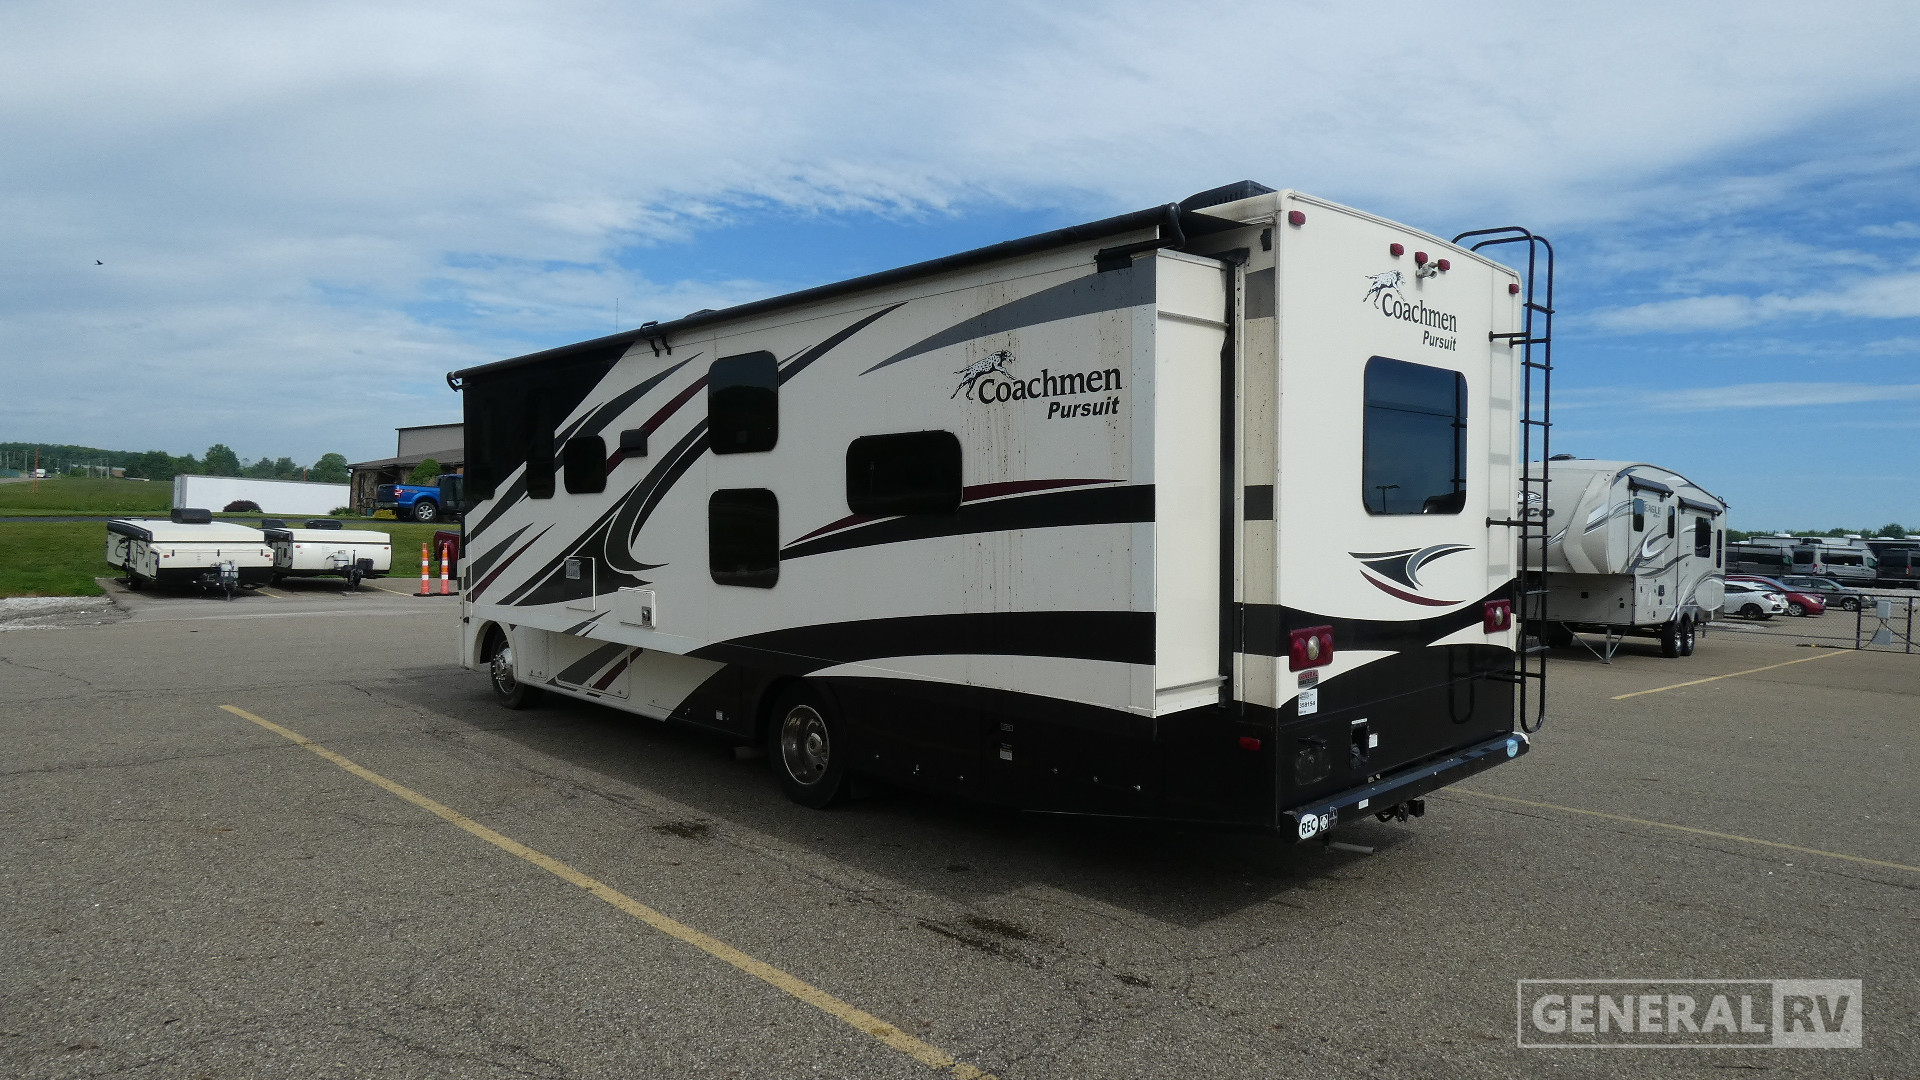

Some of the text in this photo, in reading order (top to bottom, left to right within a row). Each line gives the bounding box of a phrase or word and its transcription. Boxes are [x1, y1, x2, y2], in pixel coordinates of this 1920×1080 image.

[1381, 292, 1457, 332] Coachmen
[1422, 330, 1457, 351] Pursuit
[978, 368, 1122, 404] Coachmen
[1047, 396, 1120, 420] Pursuit
[1644, 504, 1662, 515] EAGLE
[1301, 818, 1316, 836] REC
